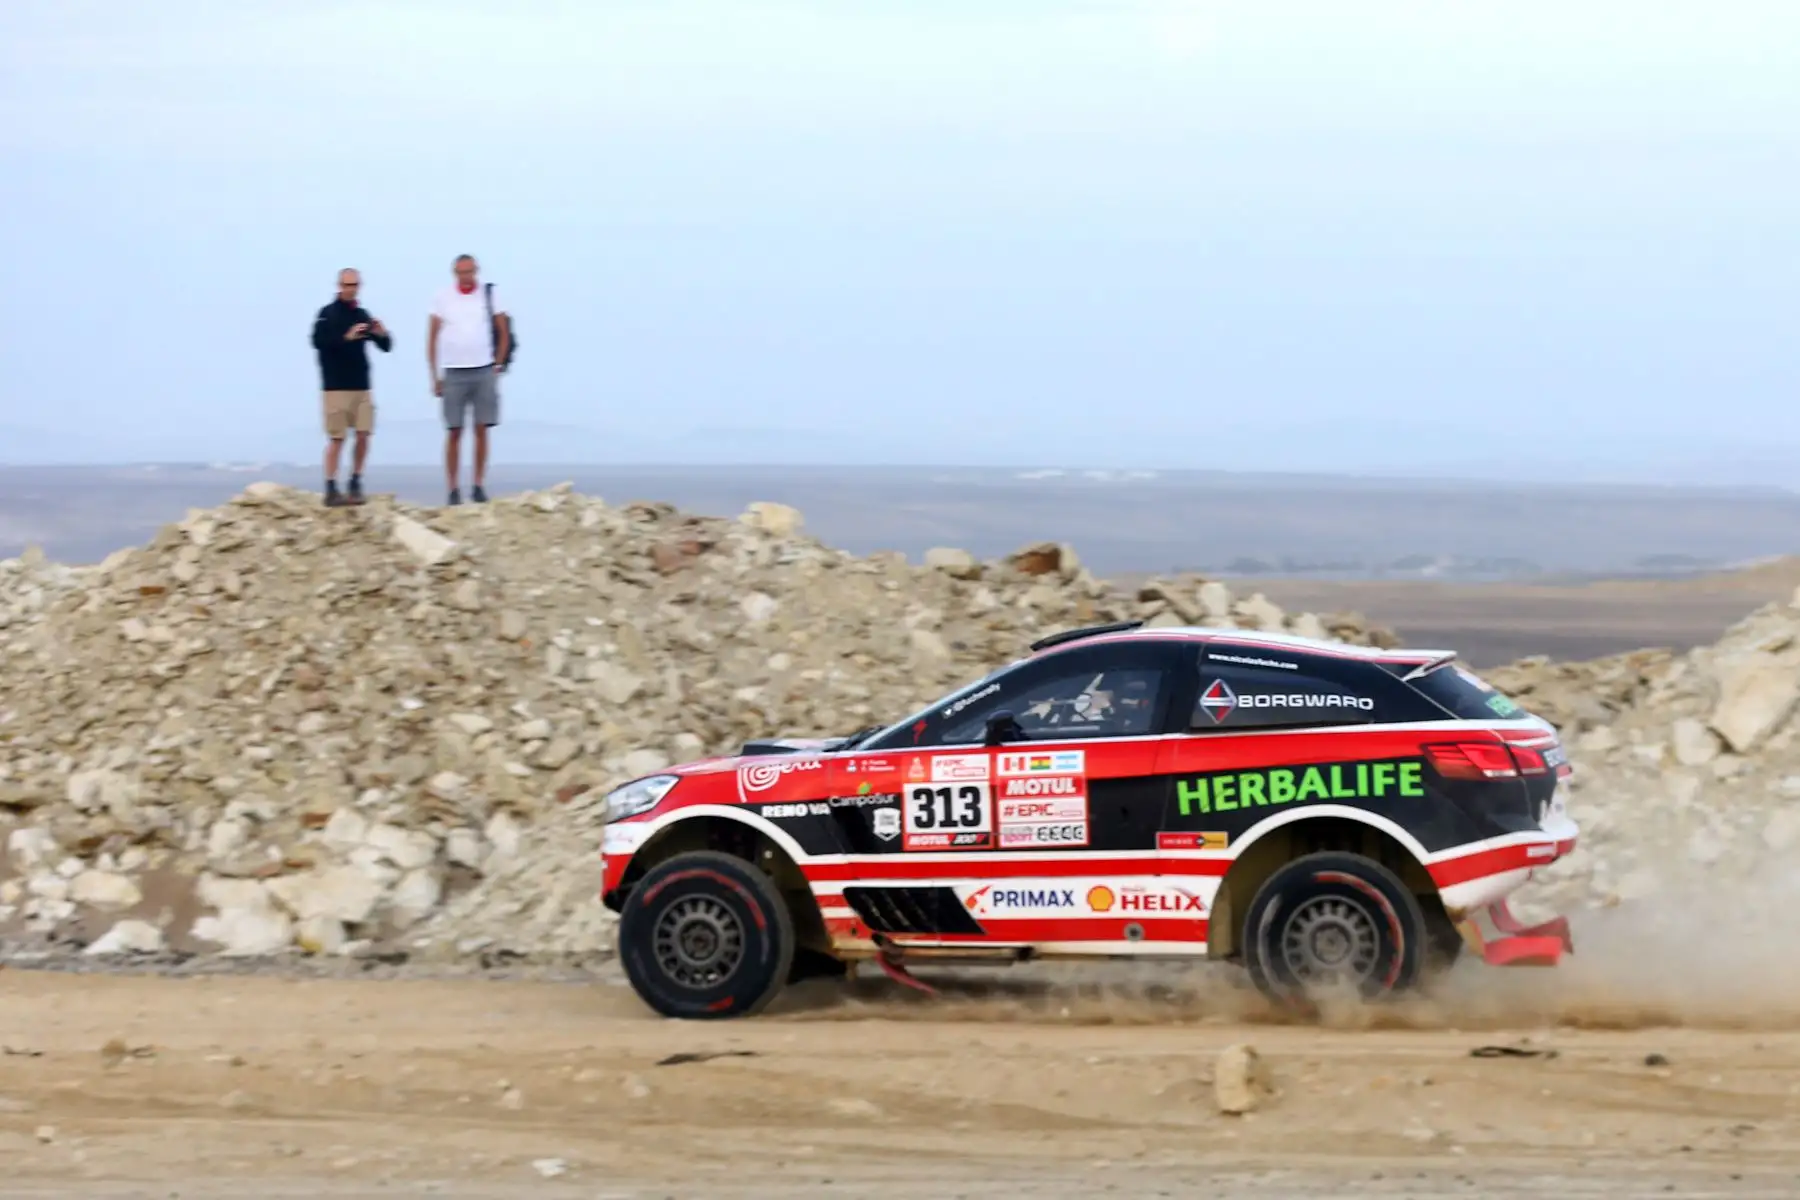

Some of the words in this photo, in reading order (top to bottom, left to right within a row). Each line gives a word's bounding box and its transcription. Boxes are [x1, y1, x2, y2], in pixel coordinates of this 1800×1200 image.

[1238, 694, 1374, 710] BORGWARD
[1006, 777, 1076, 796] MOTUL
[1176, 762, 1424, 816] HERBALIFE
[912, 786, 981, 829] 313
[993, 890, 1074, 907] PRIMAX
[1121, 894, 1204, 911] HELIX
